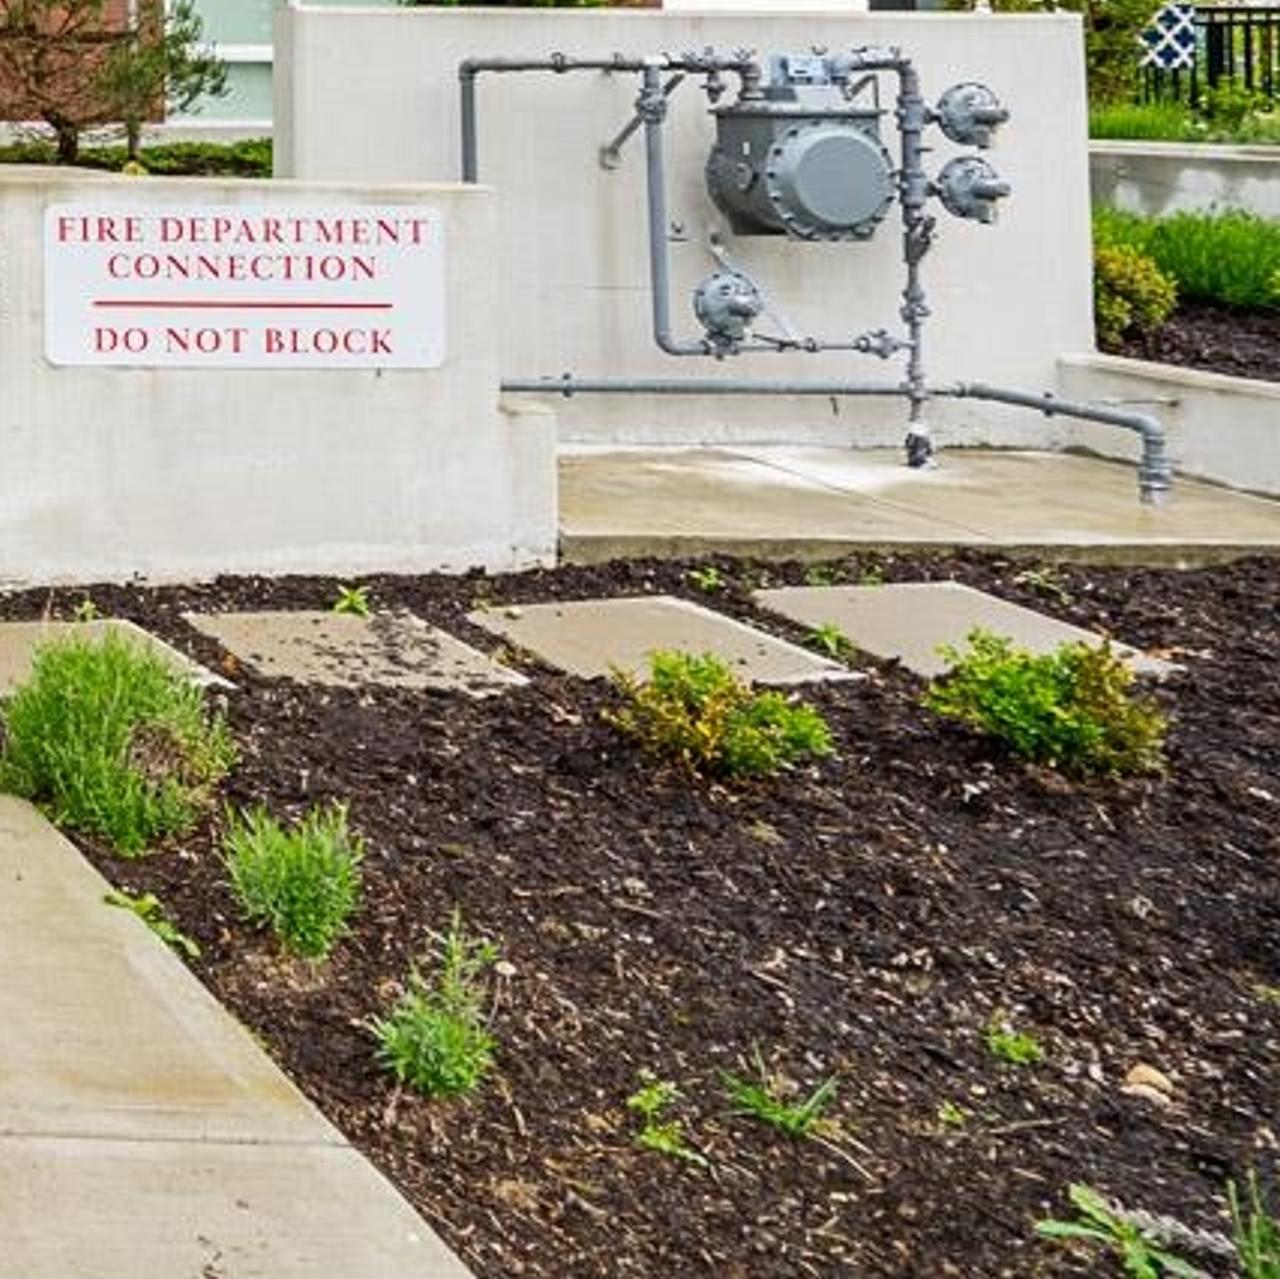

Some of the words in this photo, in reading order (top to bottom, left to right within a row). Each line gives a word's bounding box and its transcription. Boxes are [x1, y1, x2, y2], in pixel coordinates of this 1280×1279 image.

[57, 216, 142, 243] FIRE
[159, 216, 428, 244] DEPARTMENT
[107, 254, 378, 281] CONNECTION
[94, 327, 150, 353] DO
[165, 327, 248, 354] NOT
[264, 328, 394, 355] BLOCK
